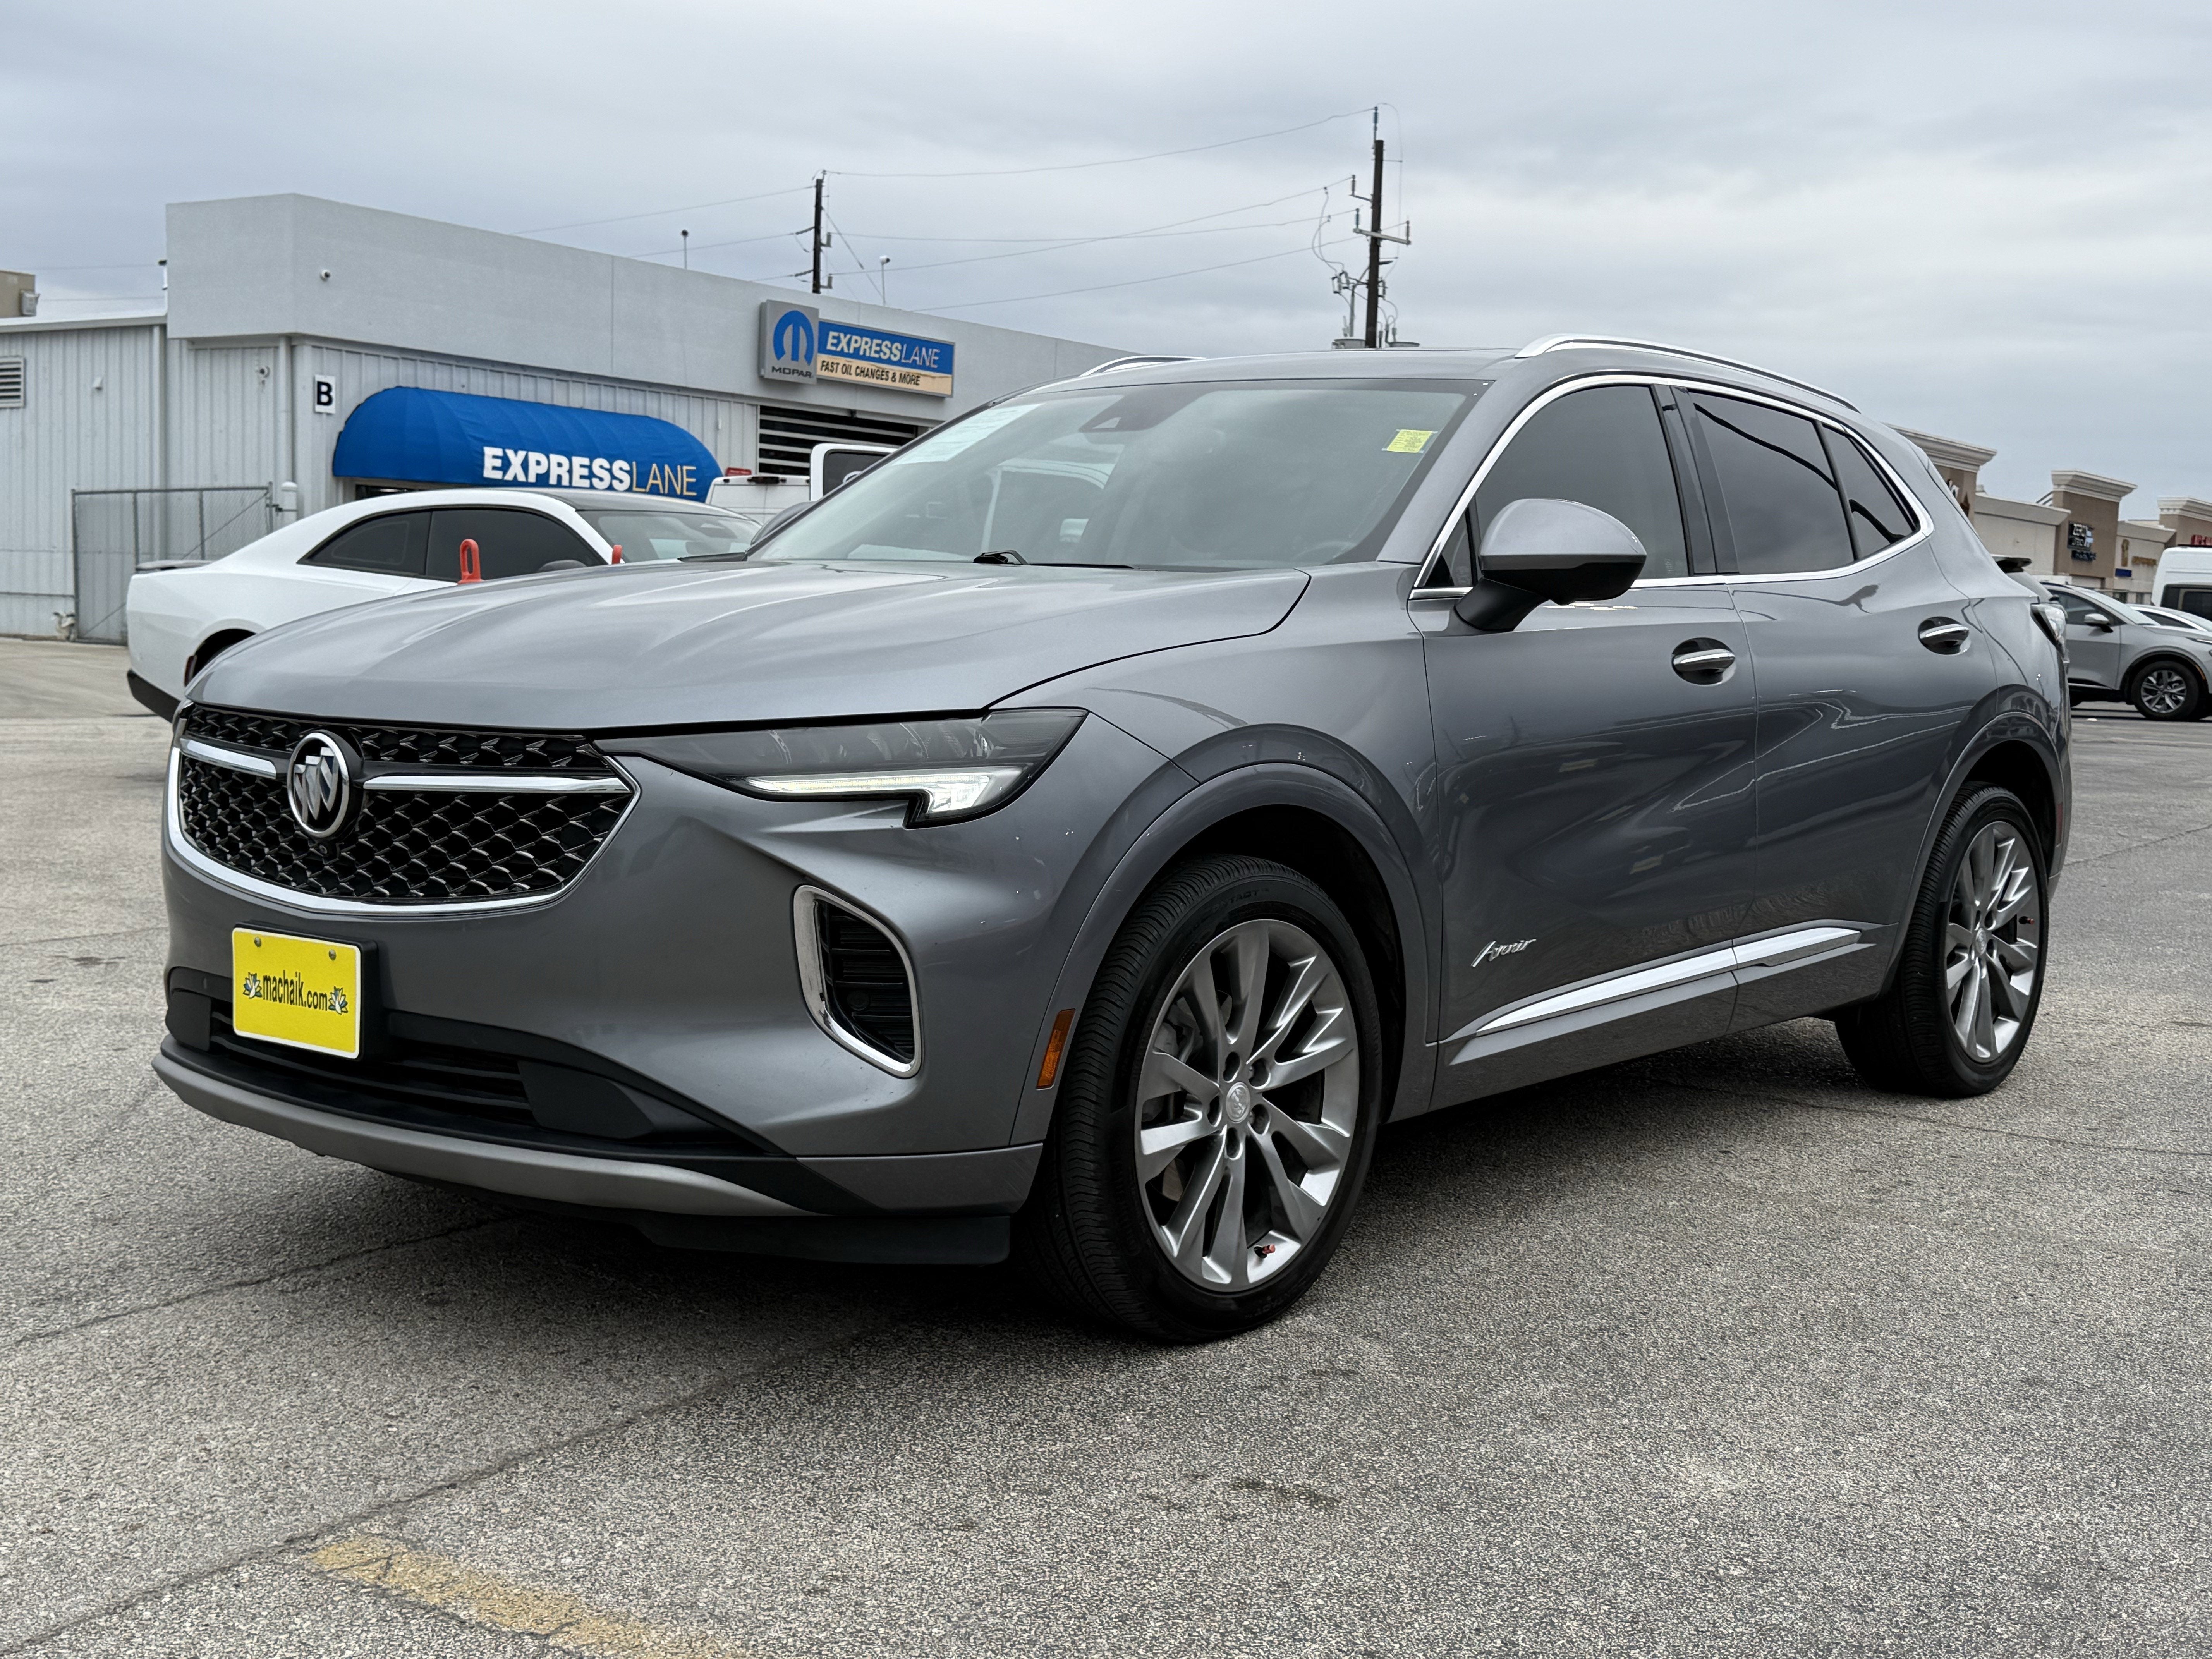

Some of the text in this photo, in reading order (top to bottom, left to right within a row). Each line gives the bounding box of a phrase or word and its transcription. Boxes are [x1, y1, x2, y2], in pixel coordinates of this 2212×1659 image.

[771, 366, 812, 378] MOPAR
[820, 360, 921, 386] FAST OIL CHANGES & MORE
[317, 381, 333, 406] B
[263, 970, 328, 1011] machaik.com
